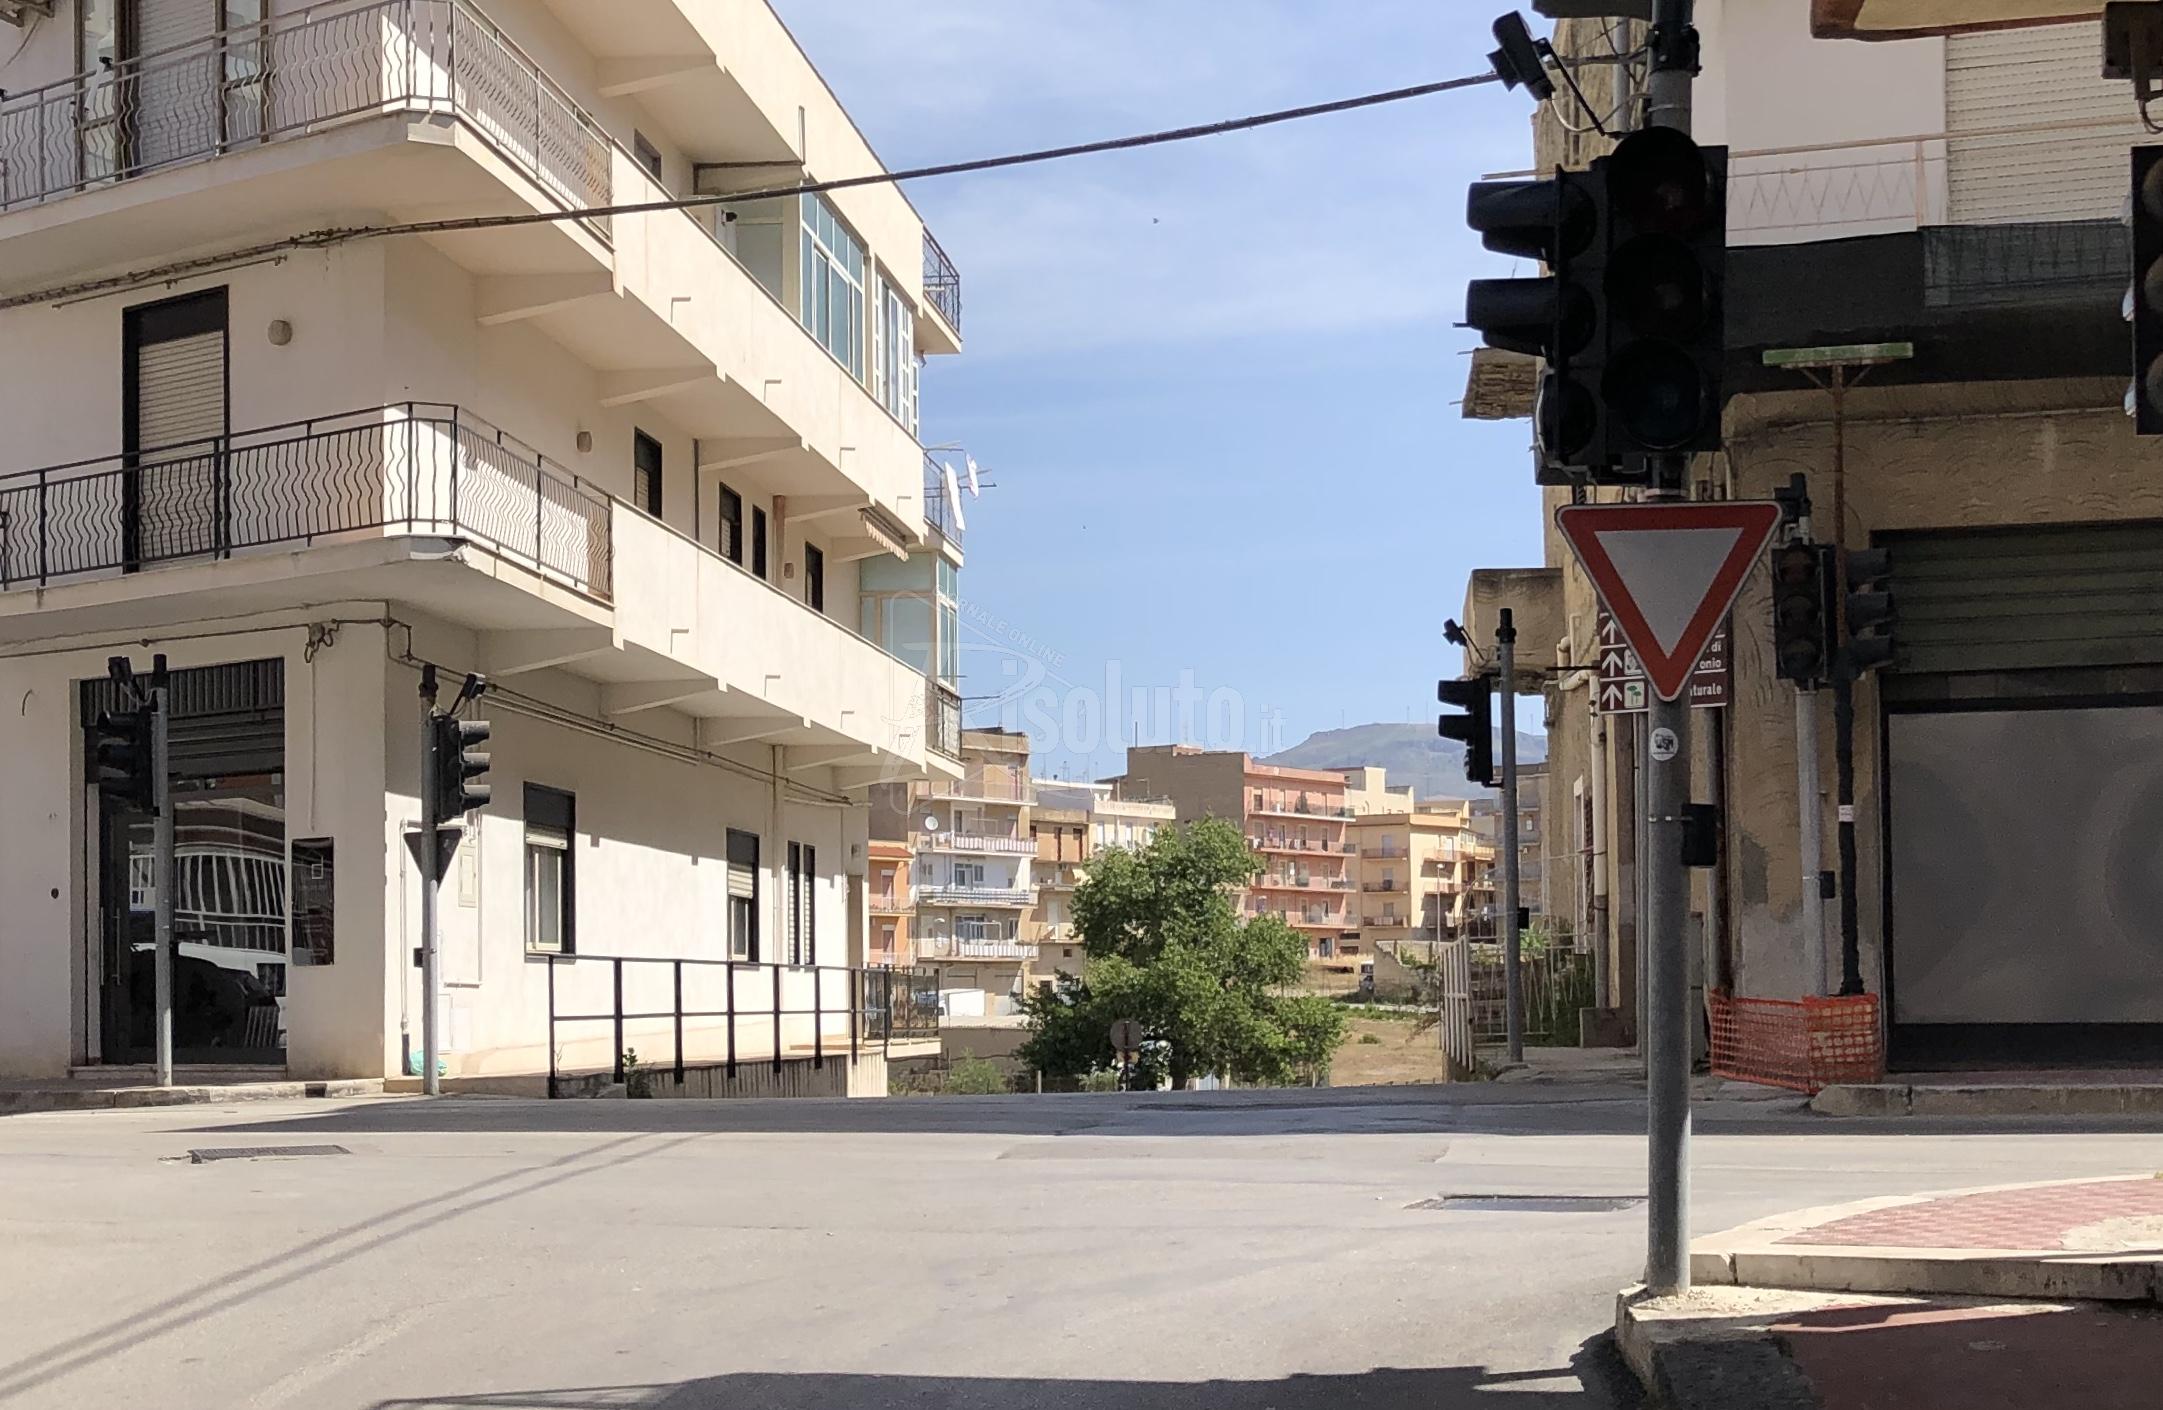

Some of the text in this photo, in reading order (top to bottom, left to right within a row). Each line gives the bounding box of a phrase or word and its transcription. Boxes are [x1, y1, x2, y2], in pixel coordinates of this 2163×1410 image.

[1711, 640, 1722, 652] di
[1699, 656, 1722, 669] onio
[1689, 682, 1723, 697] turale
